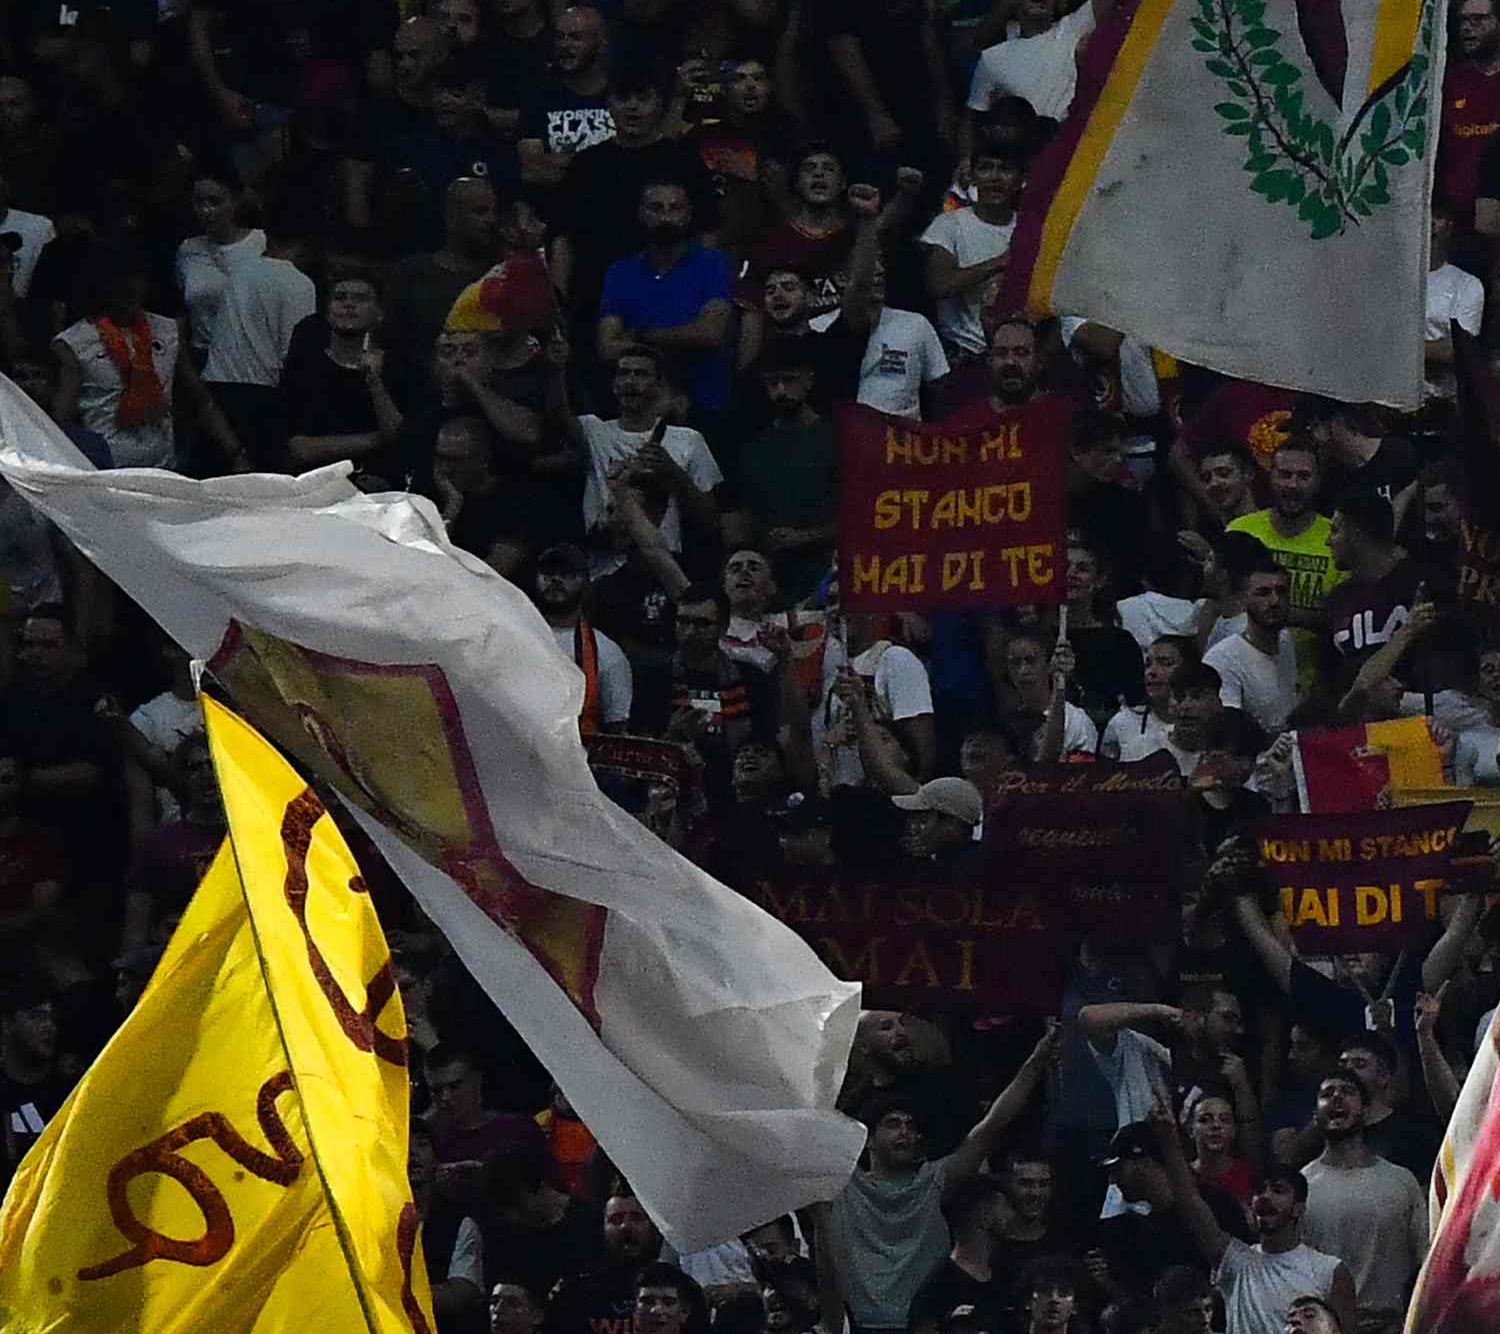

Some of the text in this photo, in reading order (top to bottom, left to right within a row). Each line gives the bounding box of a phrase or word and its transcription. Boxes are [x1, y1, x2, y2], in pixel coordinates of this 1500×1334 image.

[980, 424, 1022, 460] MI
[874, 482, 1032, 532] STANCO
[853, 544, 1055, 595] MAI DI TE
[1317, 837, 1352, 863] MI
[1354, 881, 1404, 927] DI
[1412, 877, 1443, 921] T
